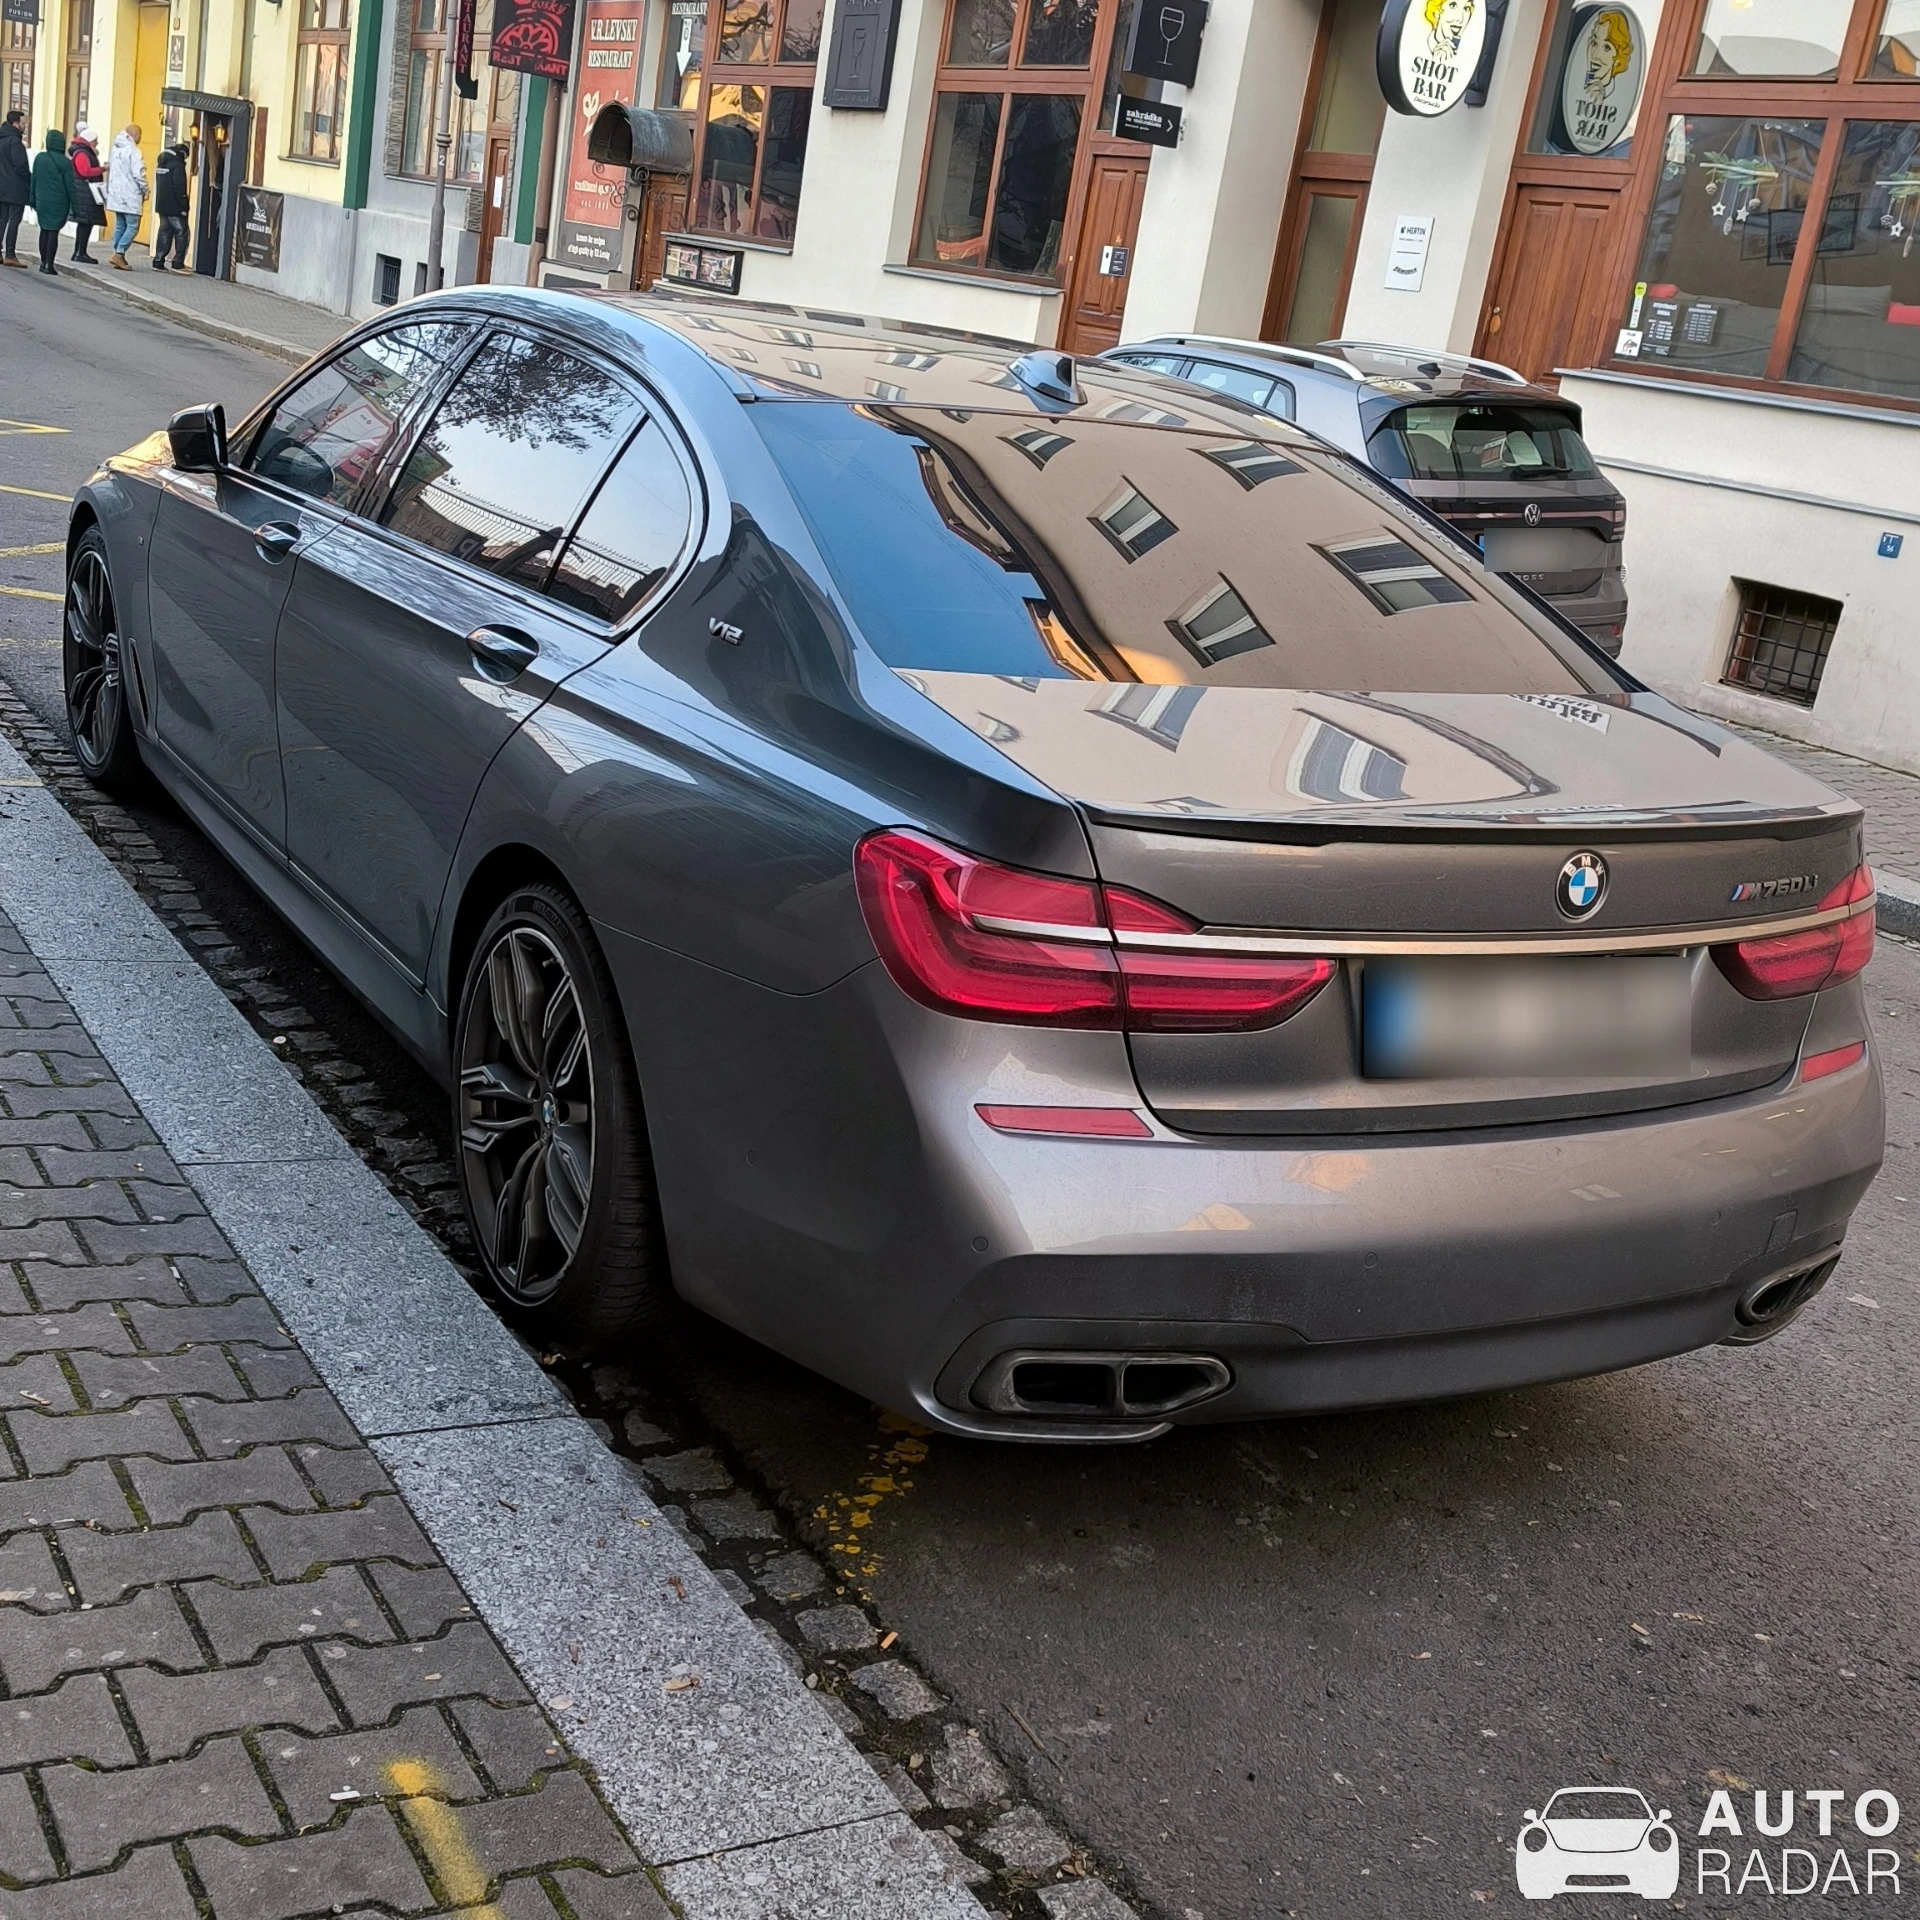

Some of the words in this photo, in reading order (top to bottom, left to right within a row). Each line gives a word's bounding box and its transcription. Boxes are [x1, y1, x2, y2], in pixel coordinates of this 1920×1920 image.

[8, 8, 33, 18] FUSION
[672, 2, 708, 15] RESTAURANT
[460, 0, 473, 74] TAURANT
[587, 49, 634, 68] RESTAURANT
[1411, 56, 1459, 83] SHOT
[1412, 77, 1447, 101] BAR
[1126, 109, 1162, 123] zahrádka
[438, 154, 446, 166] 2
[709, 617, 743, 645] V12
[1564, 855, 1604, 877] BMW
